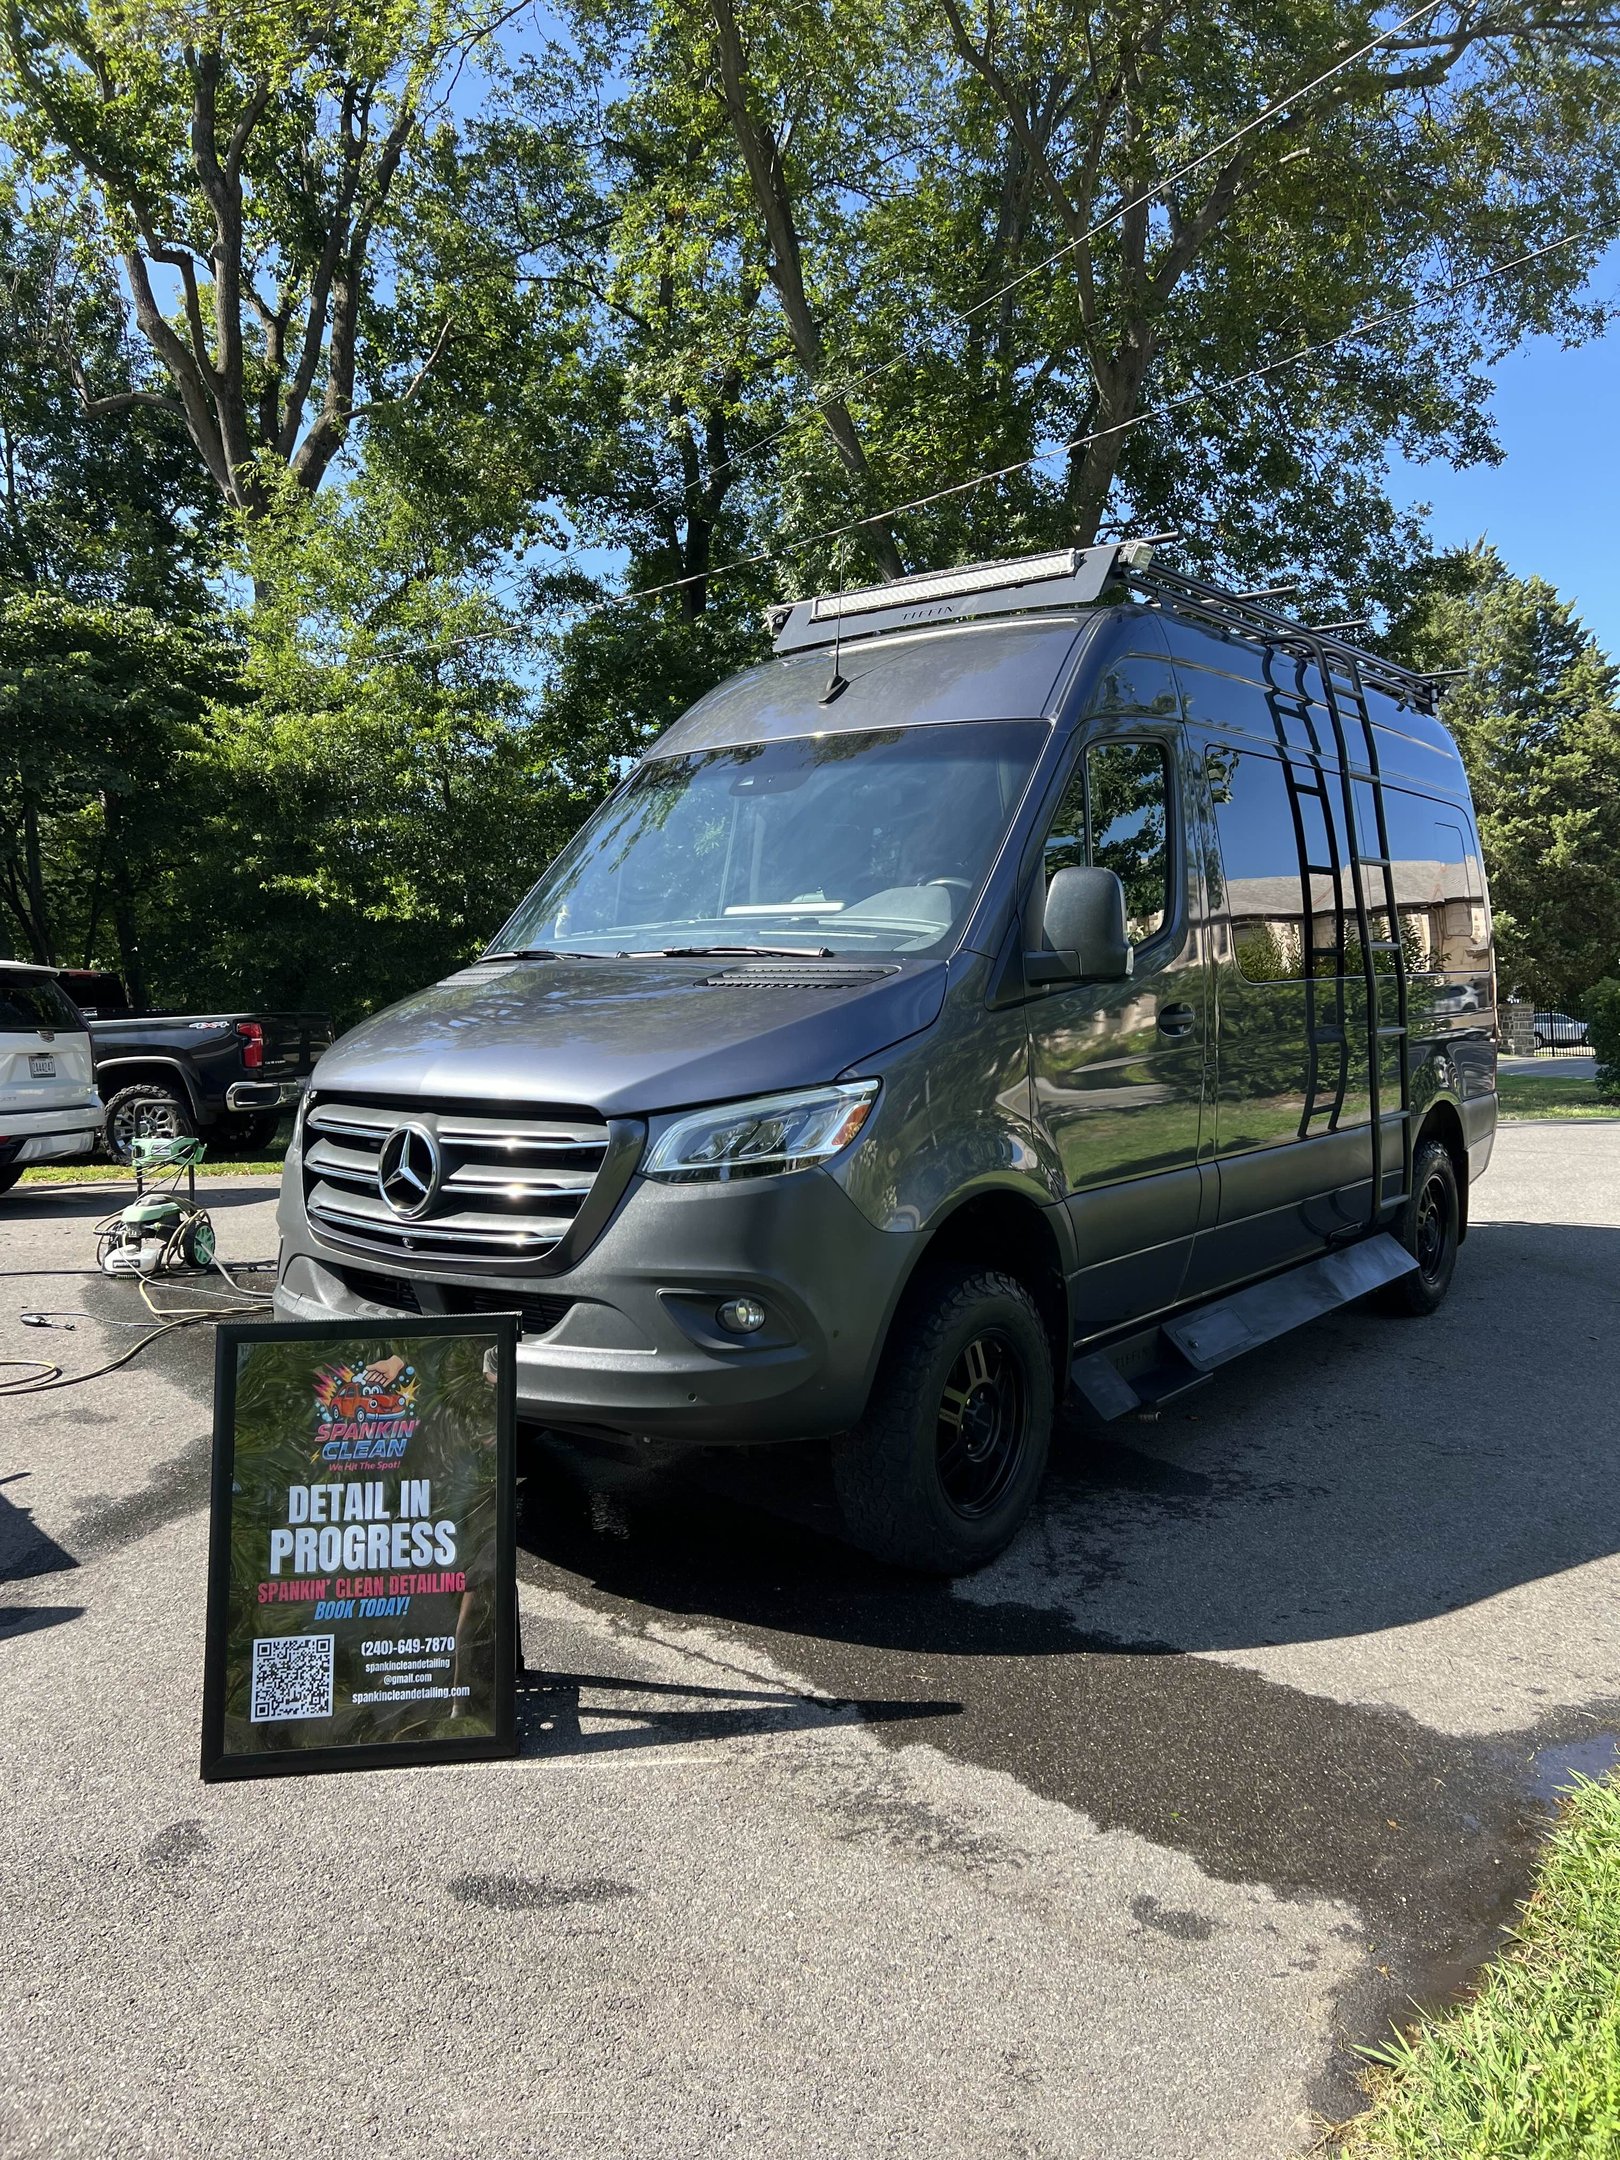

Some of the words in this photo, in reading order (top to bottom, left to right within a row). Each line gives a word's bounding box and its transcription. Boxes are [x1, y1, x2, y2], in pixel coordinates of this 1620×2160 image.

[314, 1418, 420, 1441] SPANKIN'
[322, 1439, 407, 1460] CLEAN
[329, 1463, 343, 1471] We
[345, 1463, 358, 1472] Hit
[360, 1461, 374, 1470] The
[377, 1461, 401, 1470] Spot!
[288, 1481, 391, 1524] DETAIL
[400, 1479, 430, 1518] IN
[270, 1520, 456, 1575] PROGRESS
[257, 1579, 331, 1603] SPANKIN'
[335, 1576, 384, 1598] CLEAN
[389, 1572, 466, 1595] DETAILING
[314, 1600, 354, 1620] BOOK
[358, 1597, 411, 1618] TODAY!
[361, 1636, 455, 1656] (240)-649-7870
[365, 1658, 451, 1673] spankincleandetailing
[384, 1673, 433, 1685] @gmail.com
[352, 1686, 470, 1704] spankincleandetailing.com
